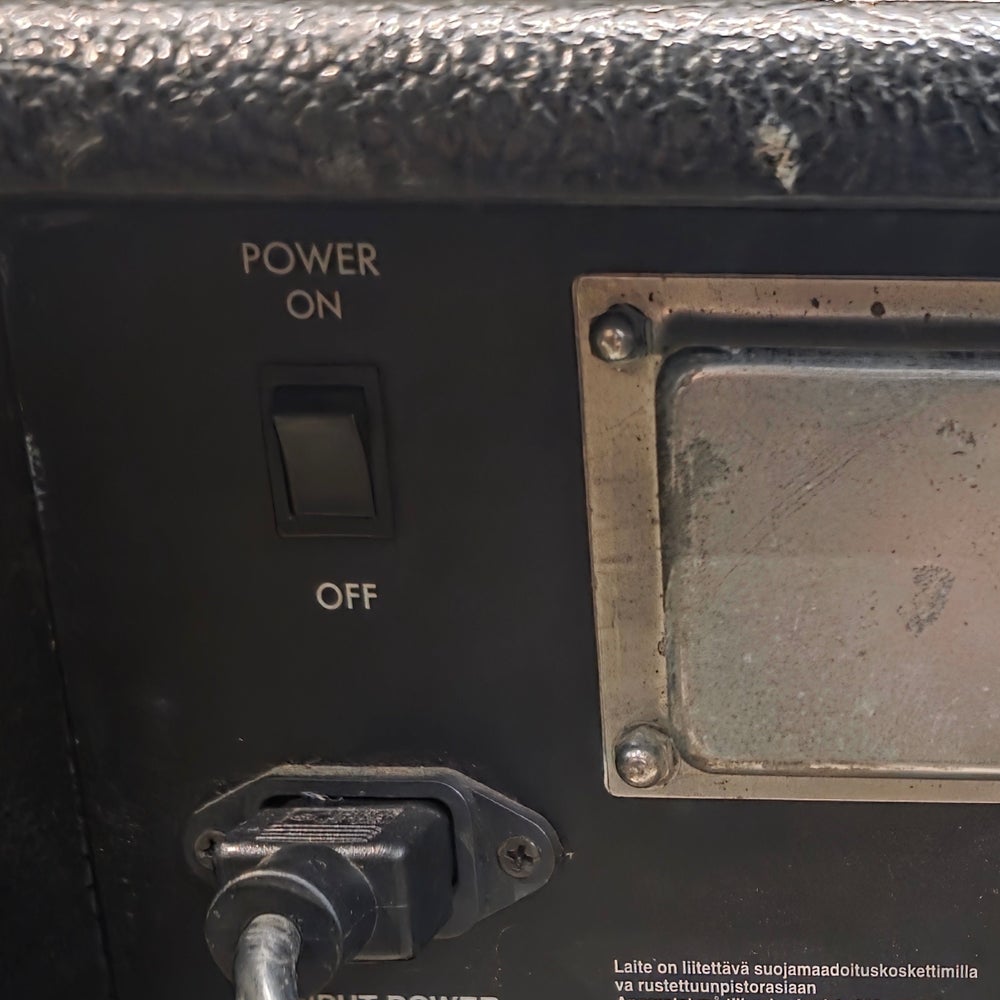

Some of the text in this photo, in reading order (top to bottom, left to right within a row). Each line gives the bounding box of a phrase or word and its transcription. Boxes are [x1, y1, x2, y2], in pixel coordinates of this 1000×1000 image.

[241, 241, 380, 277] POWER
[286, 289, 343, 320] ON
[315, 582, 378, 610] OFF
[614, 959, 978, 980] Laite on liitettävä suojamaadoituskoskettimilla
[614, 978, 817, 997] va rustettuunpistorasiaan
